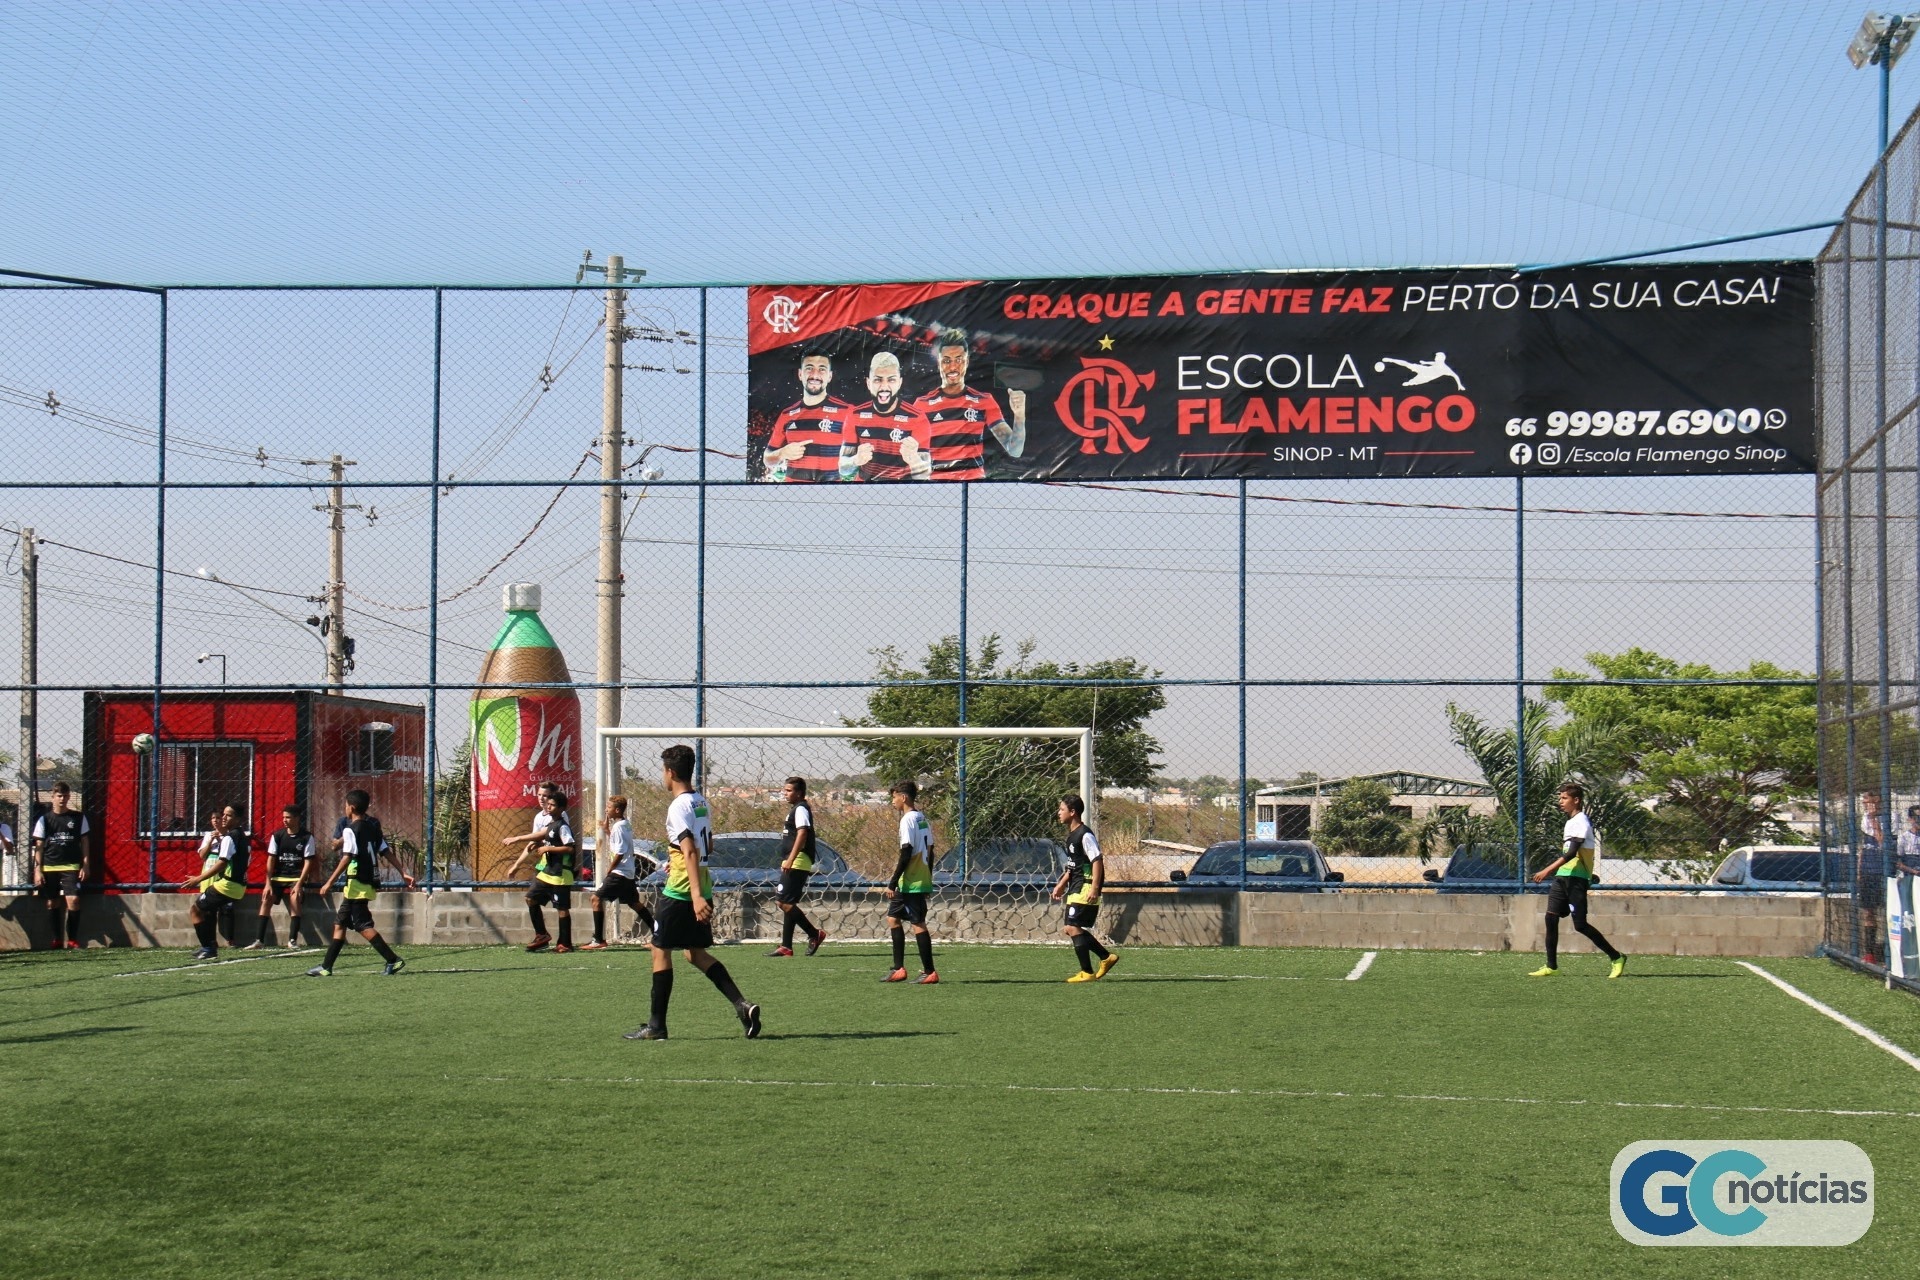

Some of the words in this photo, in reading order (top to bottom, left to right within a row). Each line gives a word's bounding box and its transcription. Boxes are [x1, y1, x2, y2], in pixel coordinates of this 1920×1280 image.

[1003, 293, 1152, 324] CRAQUE
[1158, 292, 1185, 316] A
[1196, 288, 1313, 316] GENTE
[1321, 287, 1394, 314] FAZ
[1402, 284, 1520, 312] PERTO
[1529, 283, 1580, 309] DA
[1589, 281, 1662, 309] SUA
[1673, 276, 1781, 307] CASA!
[1177, 353, 1365, 391] ESCOLA
[1177, 394, 1476, 435] FLAMENGO
[1504, 417, 1538, 437] 66
[1545, 407, 1762, 437] 99987.6900
[1273, 446, 1333, 462] SINOP
[1350, 446, 1378, 461] MT
[1564, 446, 1631, 464] /Escola
[1635, 446, 1730, 464] Flamengo
[1733, 445, 1787, 463] Sinop
[392, 754, 422, 774] AMENGO
[522, 781, 576, 799] MAJÁ
